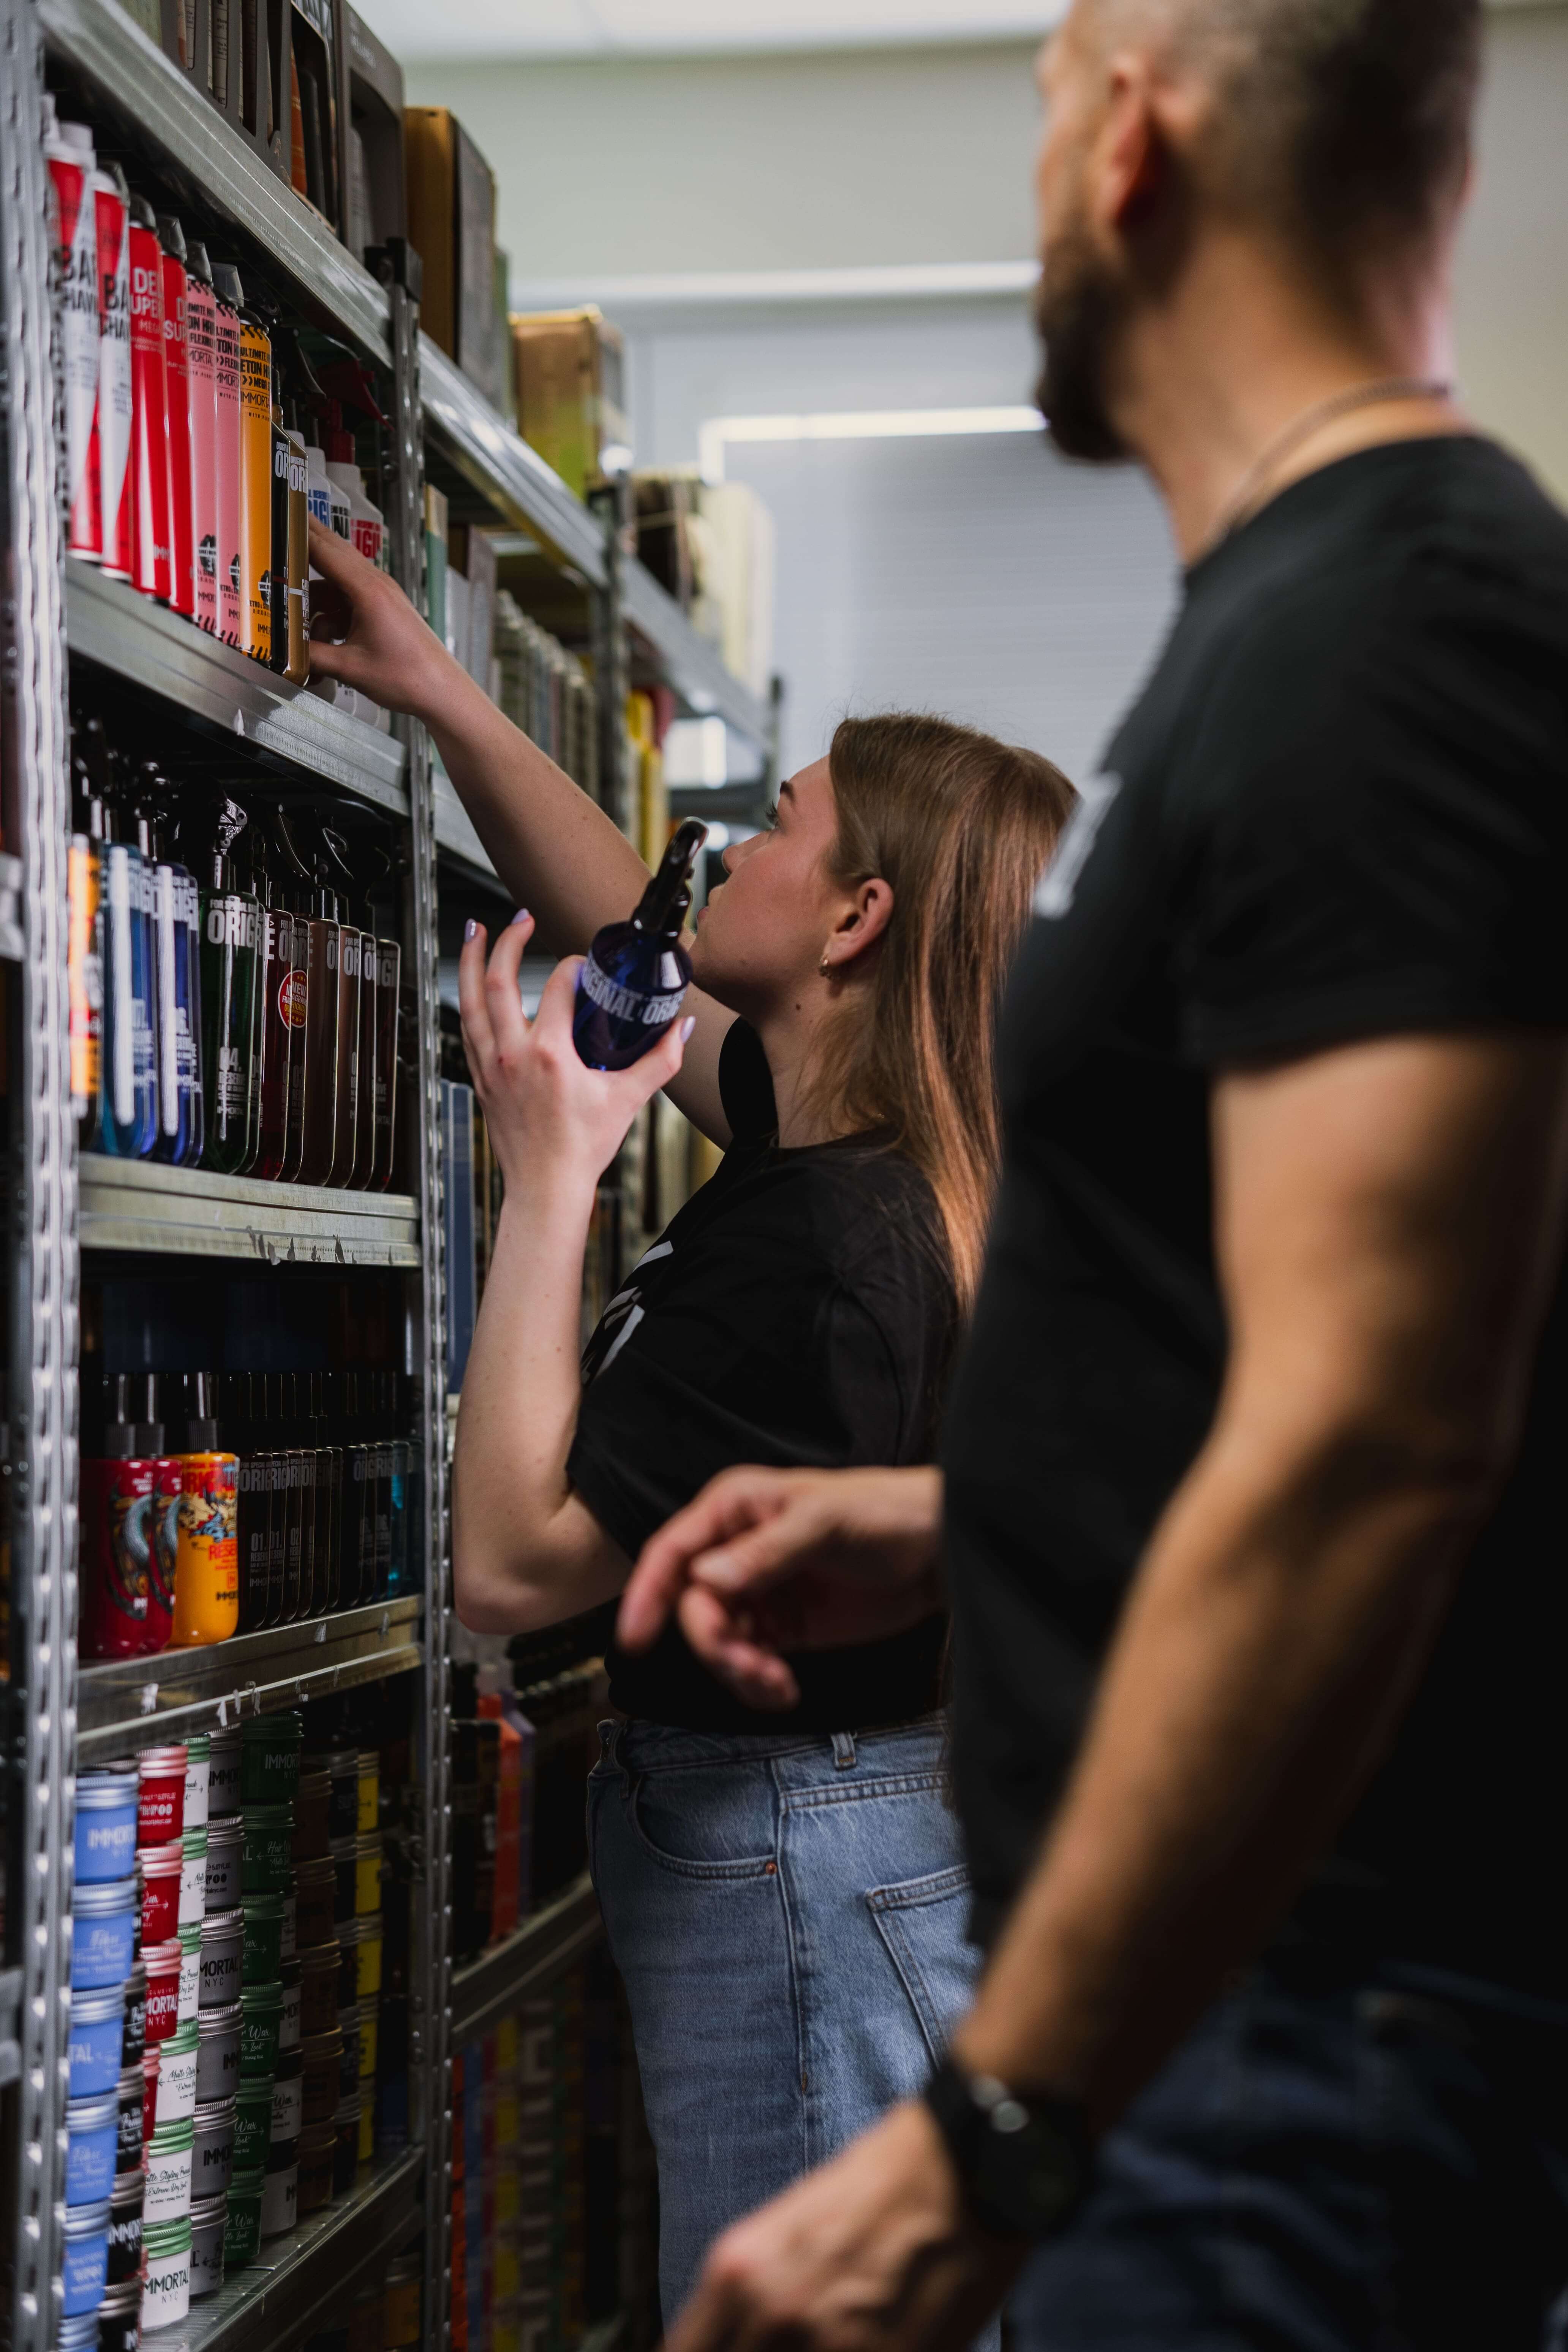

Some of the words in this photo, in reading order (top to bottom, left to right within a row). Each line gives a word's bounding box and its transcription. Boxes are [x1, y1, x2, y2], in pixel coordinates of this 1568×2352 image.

[292, 982, 307, 997] NEW
[205, 1977, 224, 1988] NYC
[148, 2015, 166, 2027] NYC
[162, 2290, 179, 2304] NYC
